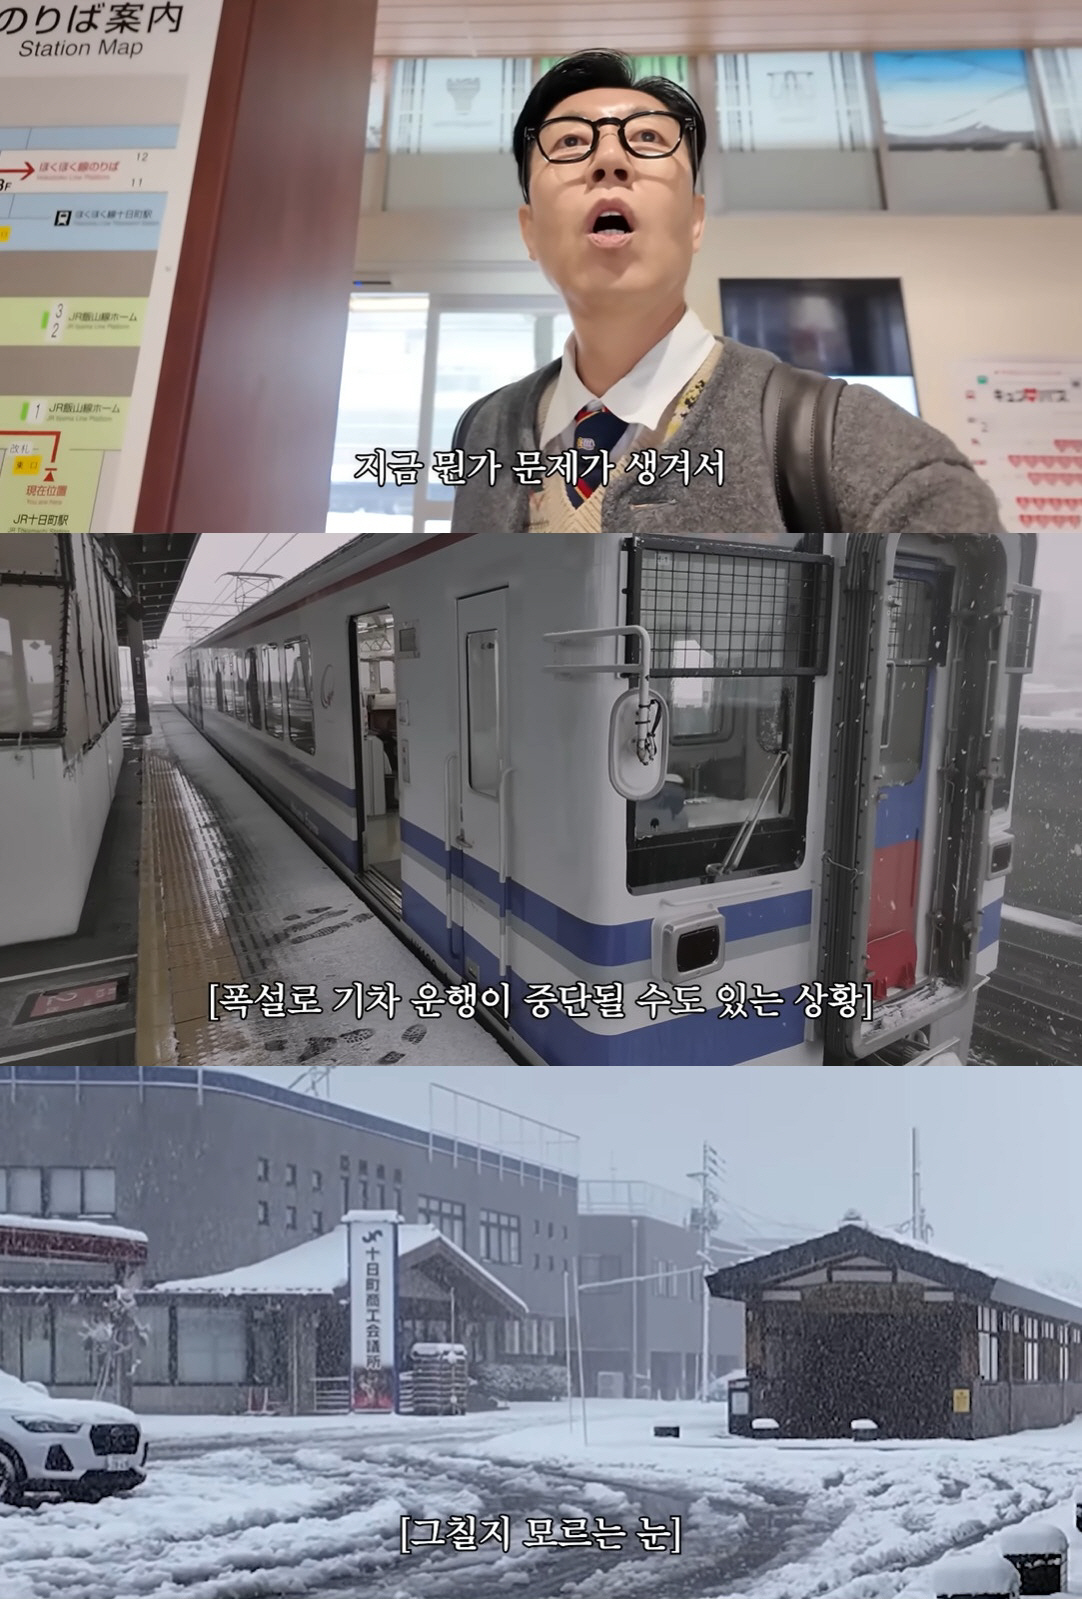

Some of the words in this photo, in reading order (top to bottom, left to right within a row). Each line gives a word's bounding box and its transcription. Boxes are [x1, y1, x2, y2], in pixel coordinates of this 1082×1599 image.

[0, 2, 184, 35] のりば案内
[19, 40, 91, 58] Station
[98, 38, 144, 59] Map
[137, 152, 149, 162] 12
[39, 161, 120, 173] ほくほく線のりば
[55, 303, 64, 319] 3
[50, 322, 60, 338] 2
[35, 403, 41, 419] 1
[48, 402, 120, 413] JR飯山線ホーム
[26, 485, 68, 497] 現在位置
[13, 513, 69, 526] JR十日町駅
[365, 1247, 382, 1370] 十日町商工会議所
